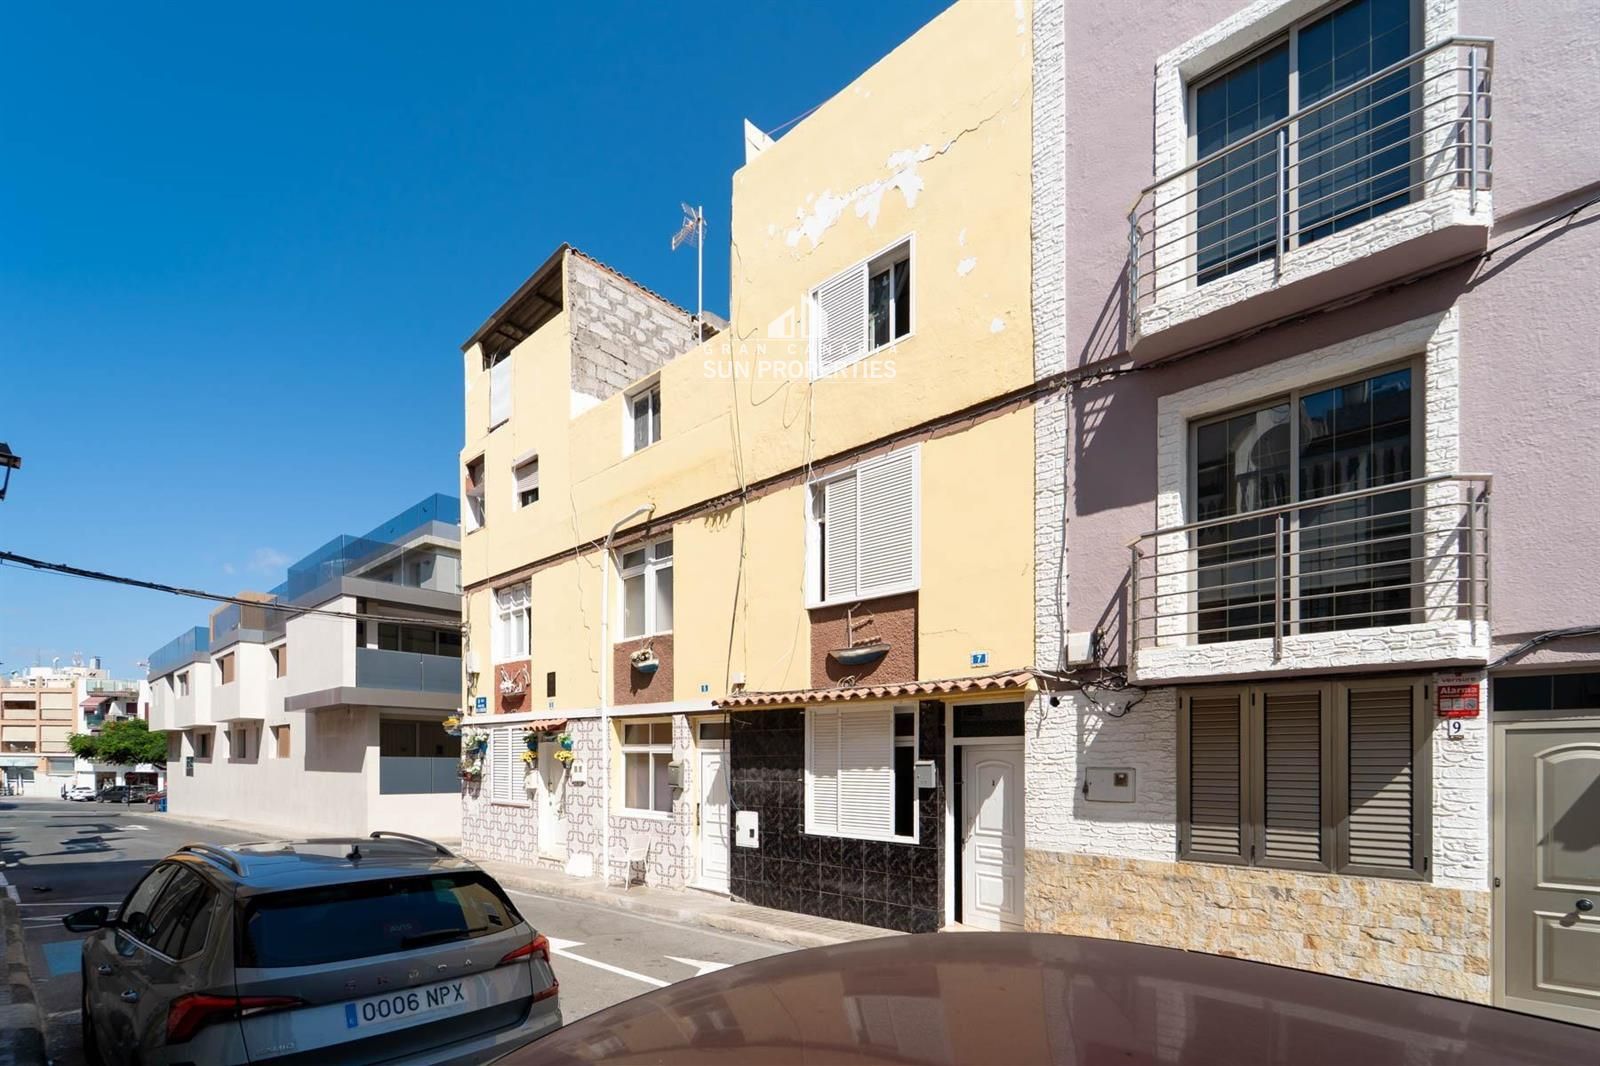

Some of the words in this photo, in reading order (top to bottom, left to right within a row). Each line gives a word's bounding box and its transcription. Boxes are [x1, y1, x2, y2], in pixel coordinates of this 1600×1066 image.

[1453, 721, 1461, 734] 9
[362, 993, 420, 1022] 0006
[426, 983, 464, 1008] NPX
